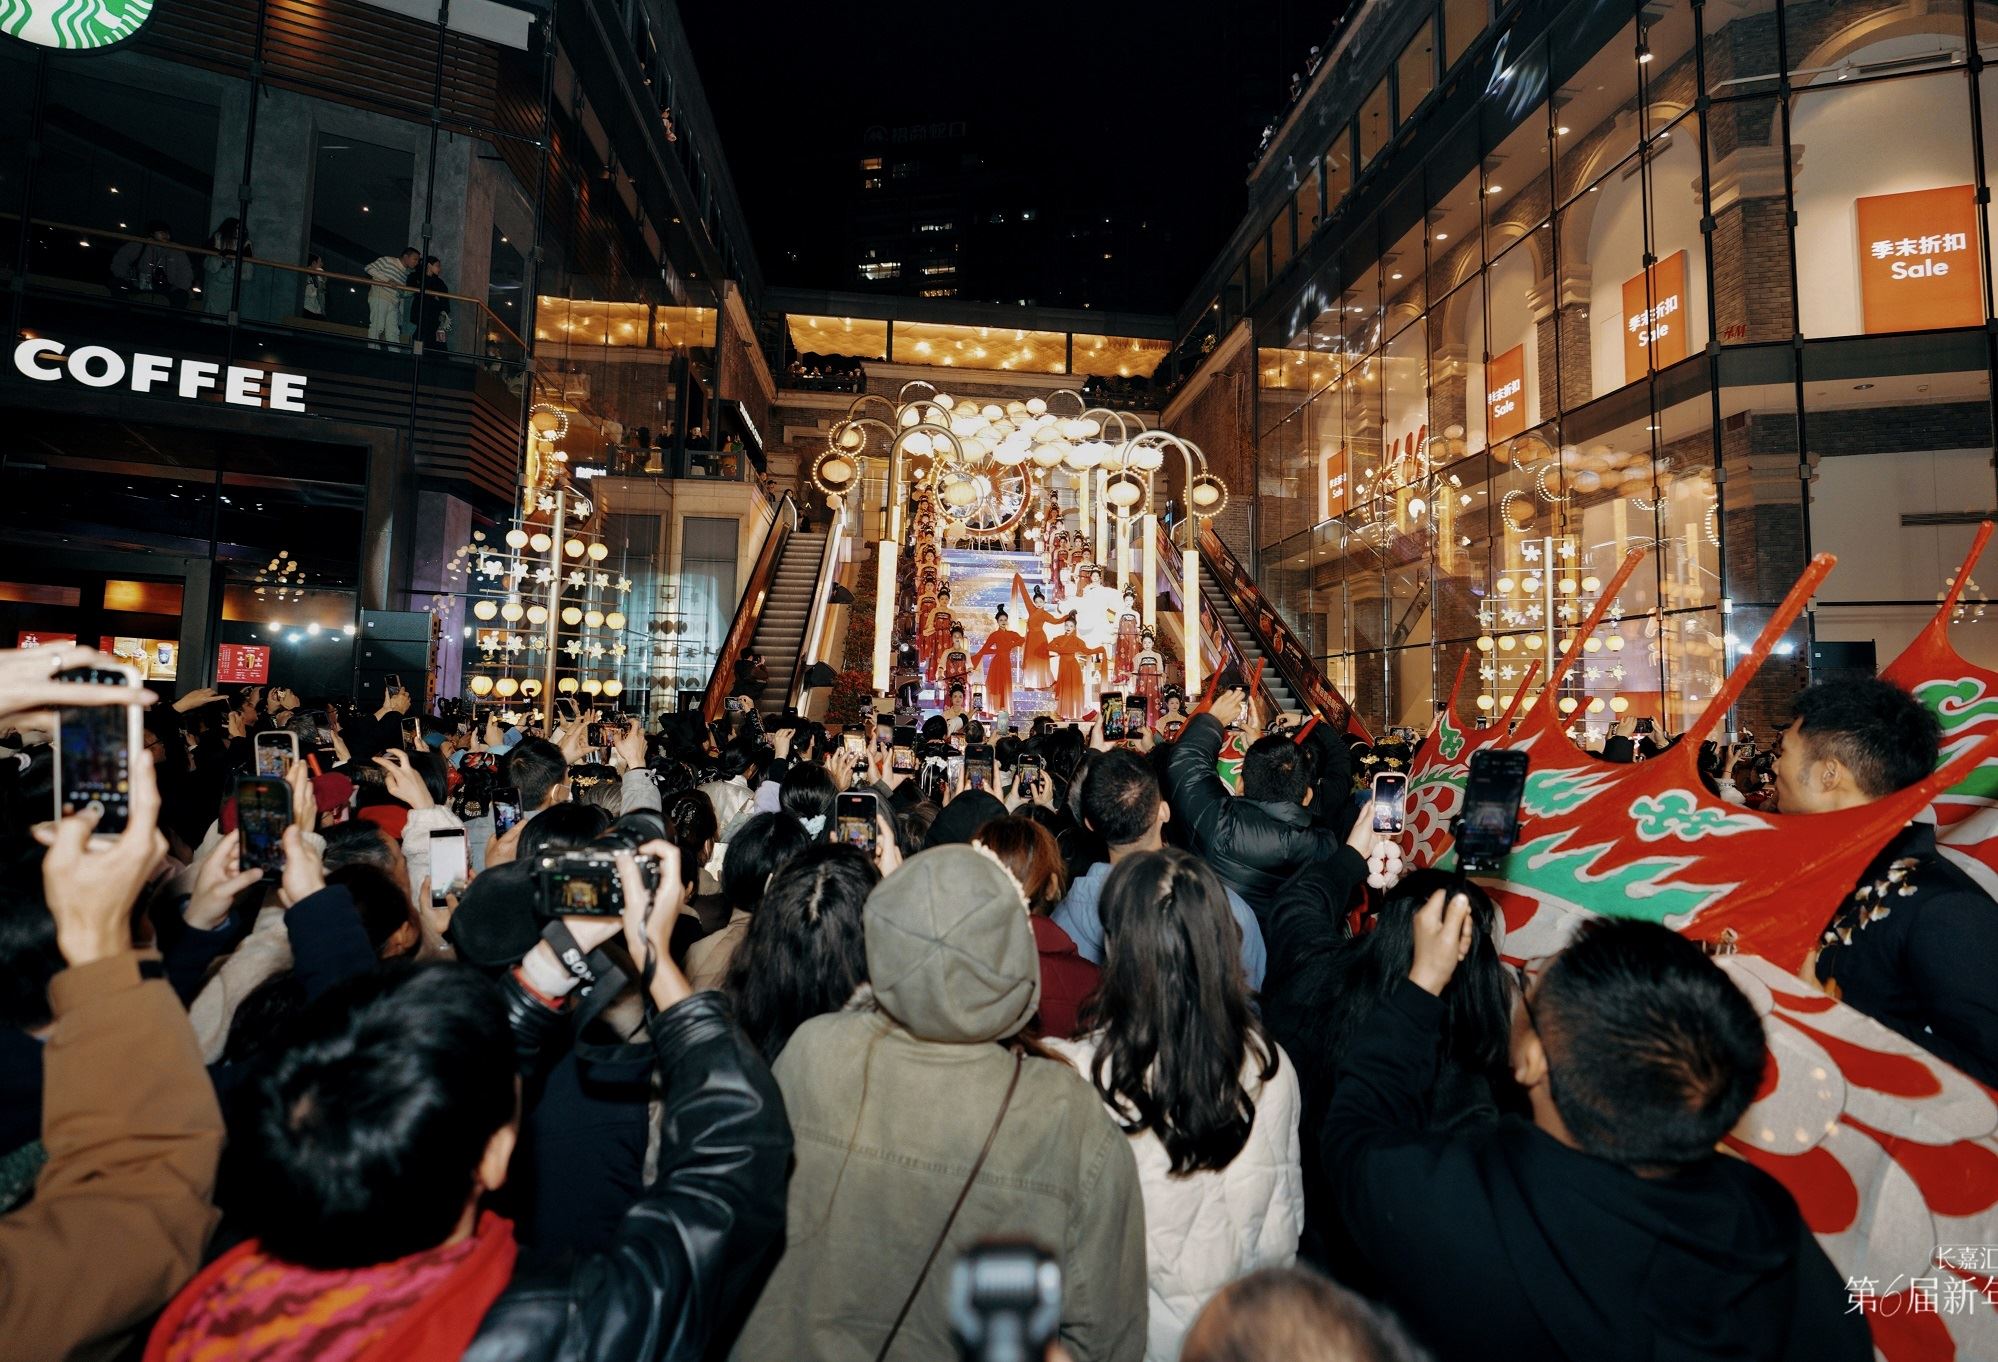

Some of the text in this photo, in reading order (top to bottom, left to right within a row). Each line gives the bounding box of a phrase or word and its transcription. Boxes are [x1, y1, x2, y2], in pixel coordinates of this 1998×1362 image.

[1871, 232, 1967, 260] 季末折扣
[1891, 258, 1949, 280] Sale
[1638, 323, 1669, 347] Sale
[14, 338, 307, 413] COFFEE
[1494, 400, 1515, 418] Sale
